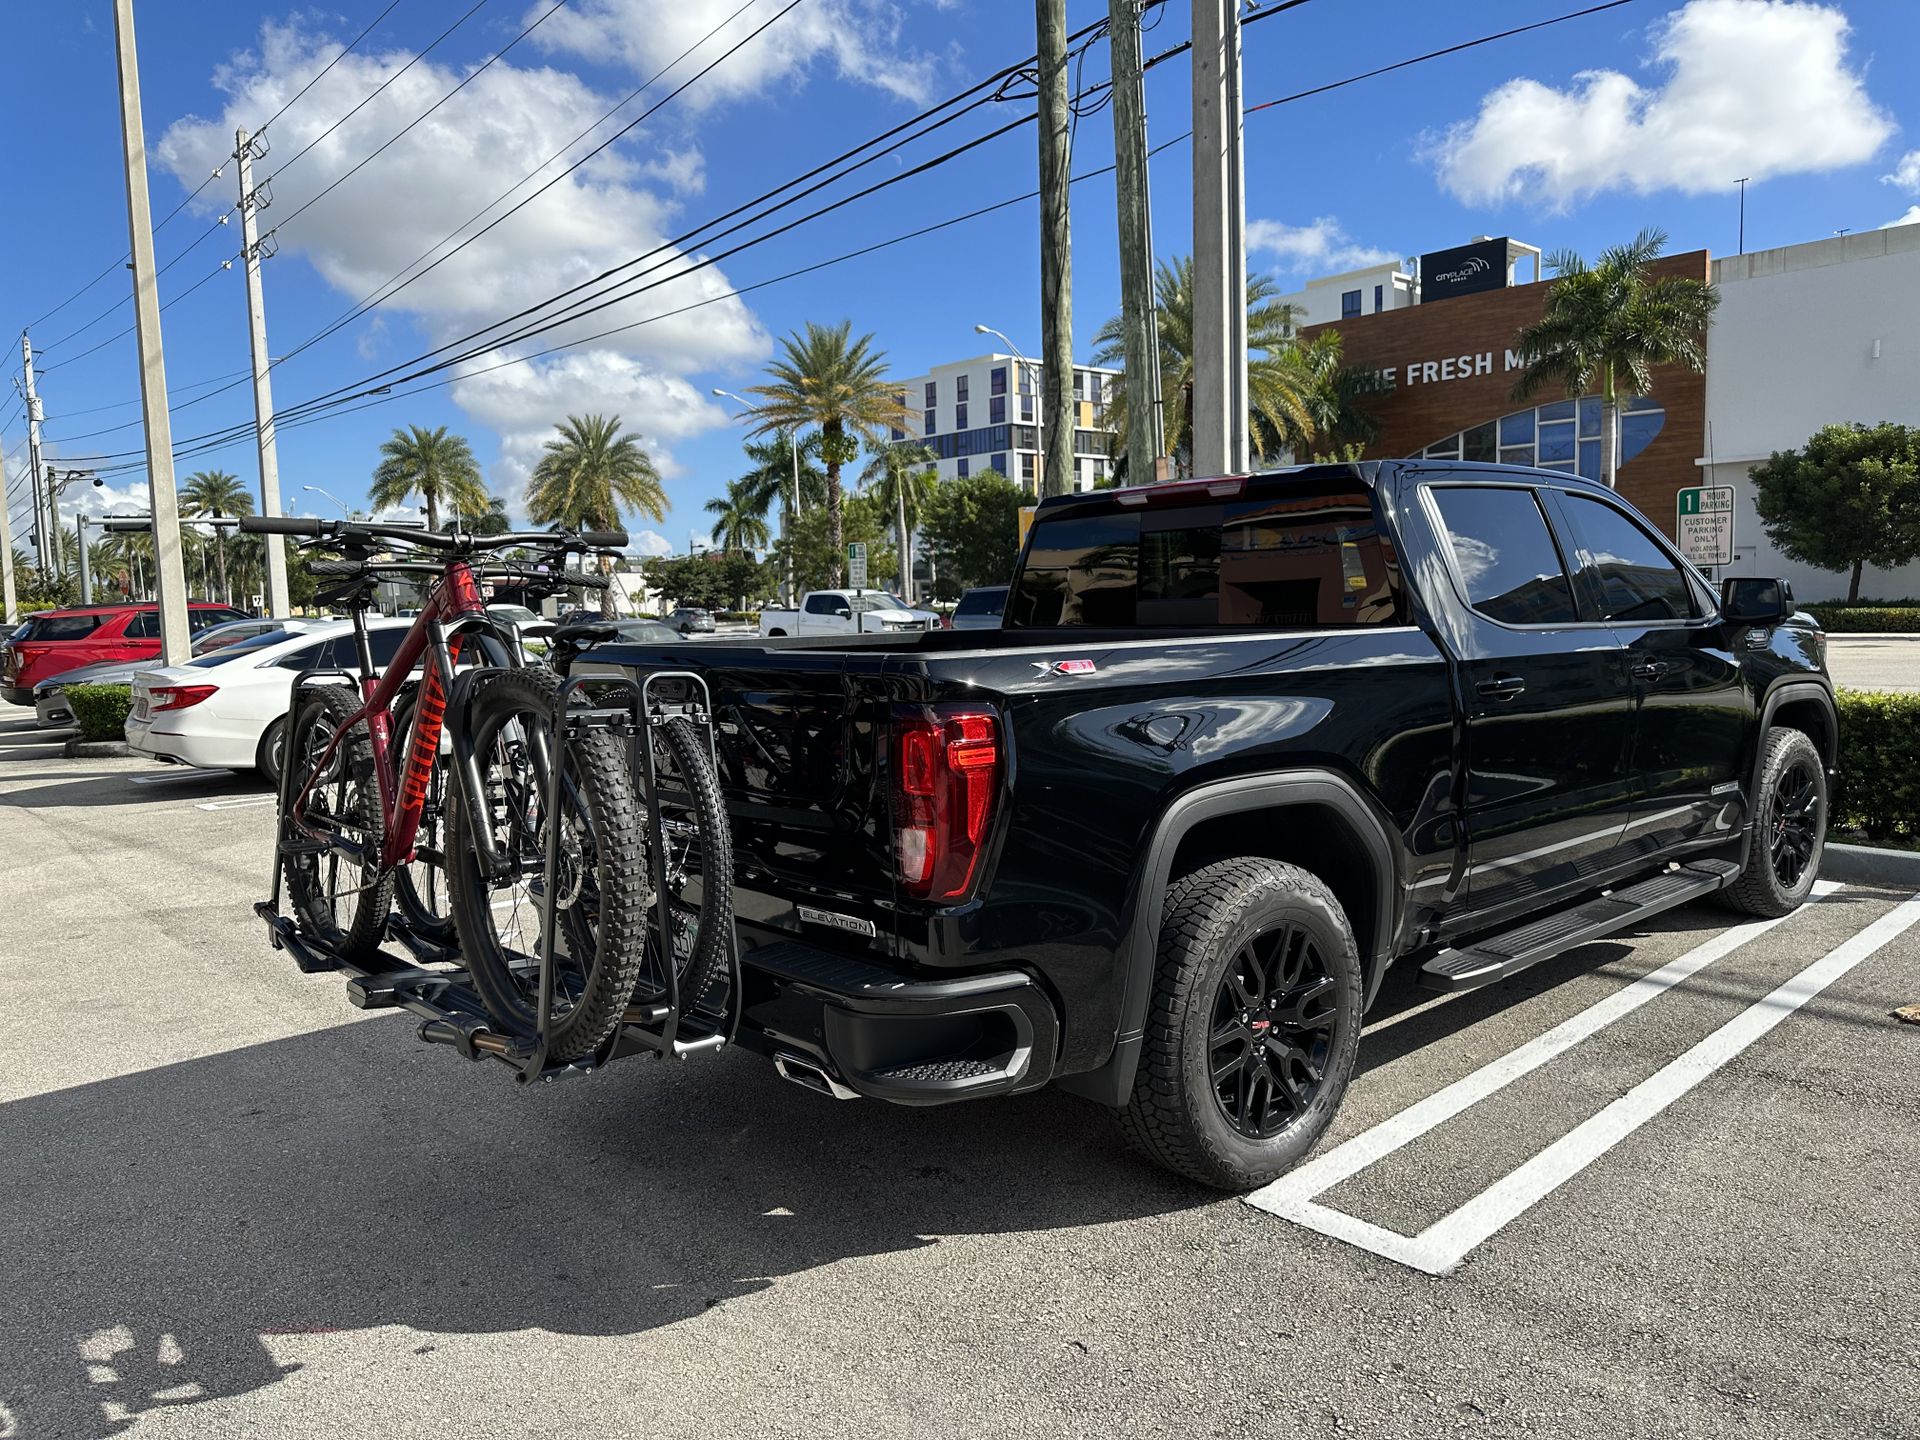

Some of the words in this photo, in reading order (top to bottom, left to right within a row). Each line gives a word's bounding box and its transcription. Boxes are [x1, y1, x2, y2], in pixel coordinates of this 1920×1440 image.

[1435, 267, 1474, 282] CITYPLACE
[1407, 352, 1493, 386] FRESH
[1706, 491, 1726, 500] HOUR
[1686, 494, 1692, 512] 1
[1700, 500, 1730, 510] PARKING
[1684, 517, 1728, 526] CUSTOMER
[1687, 526, 1723, 535] PARKING
[1694, 535, 1717, 543] ONLY
[401, 636, 461, 811] SPECIALIZ
[802, 910, 868, 933] ELEVATION
